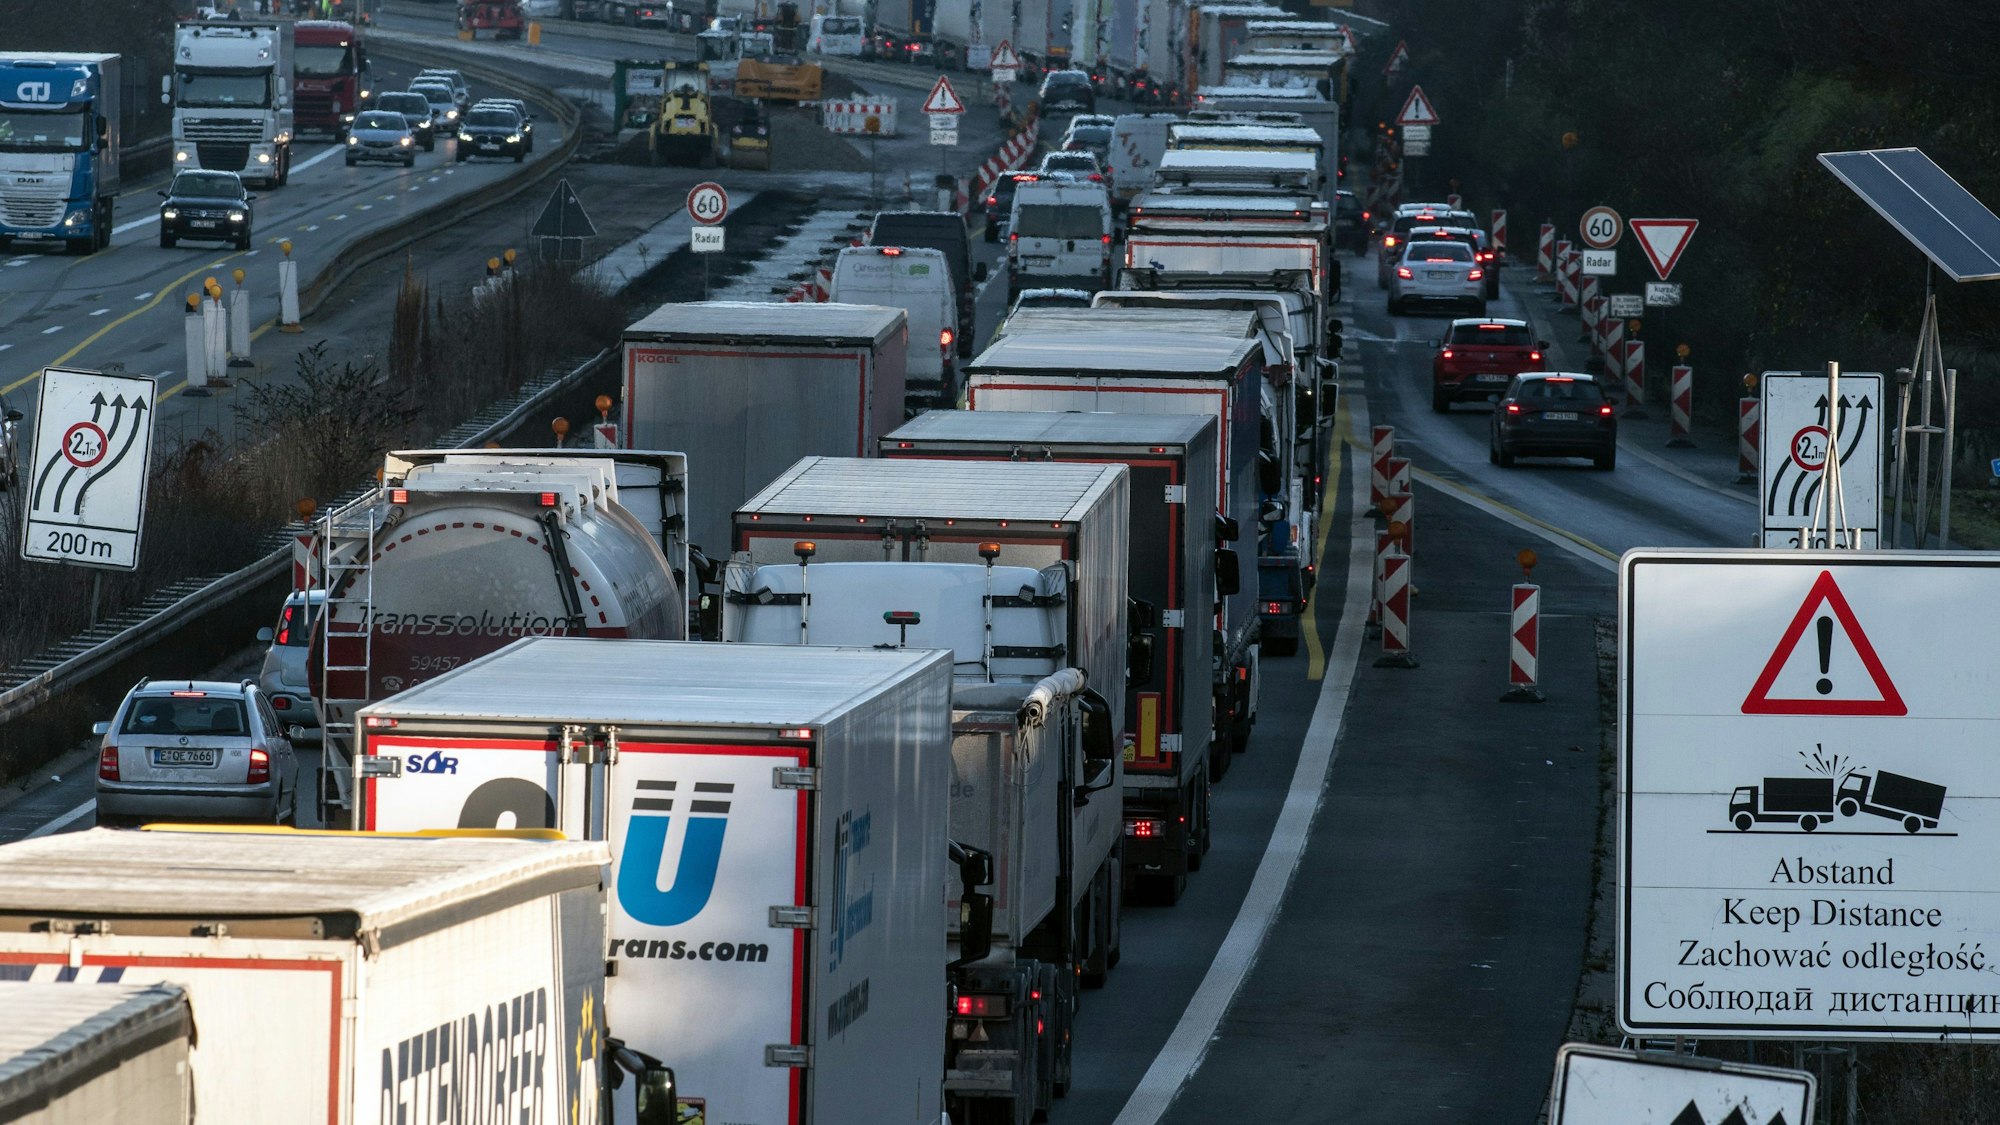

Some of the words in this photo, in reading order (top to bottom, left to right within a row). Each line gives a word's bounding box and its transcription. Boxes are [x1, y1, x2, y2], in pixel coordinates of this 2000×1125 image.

[697, 195, 719, 214] 60
[694, 232, 721, 244] Radar
[1589, 218, 1613, 237] 60
[1586, 257, 1612, 268] Radar
[637, 354, 681, 364] KÖGEL
[46, 531, 87, 555] 200
[90, 540, 112, 558] m
[357, 605, 571, 638] Transsolution
[409, 656, 461, 672] 59457
[1770, 857, 1895, 885] Abstand
[1722, 898, 1800, 933] Keep
[1811, 898, 1942, 928] Distance
[608, 938, 769, 962] rans.com
[1678, 940, 1831, 968] Zachować
[1842, 942, 1986, 977] odległość
